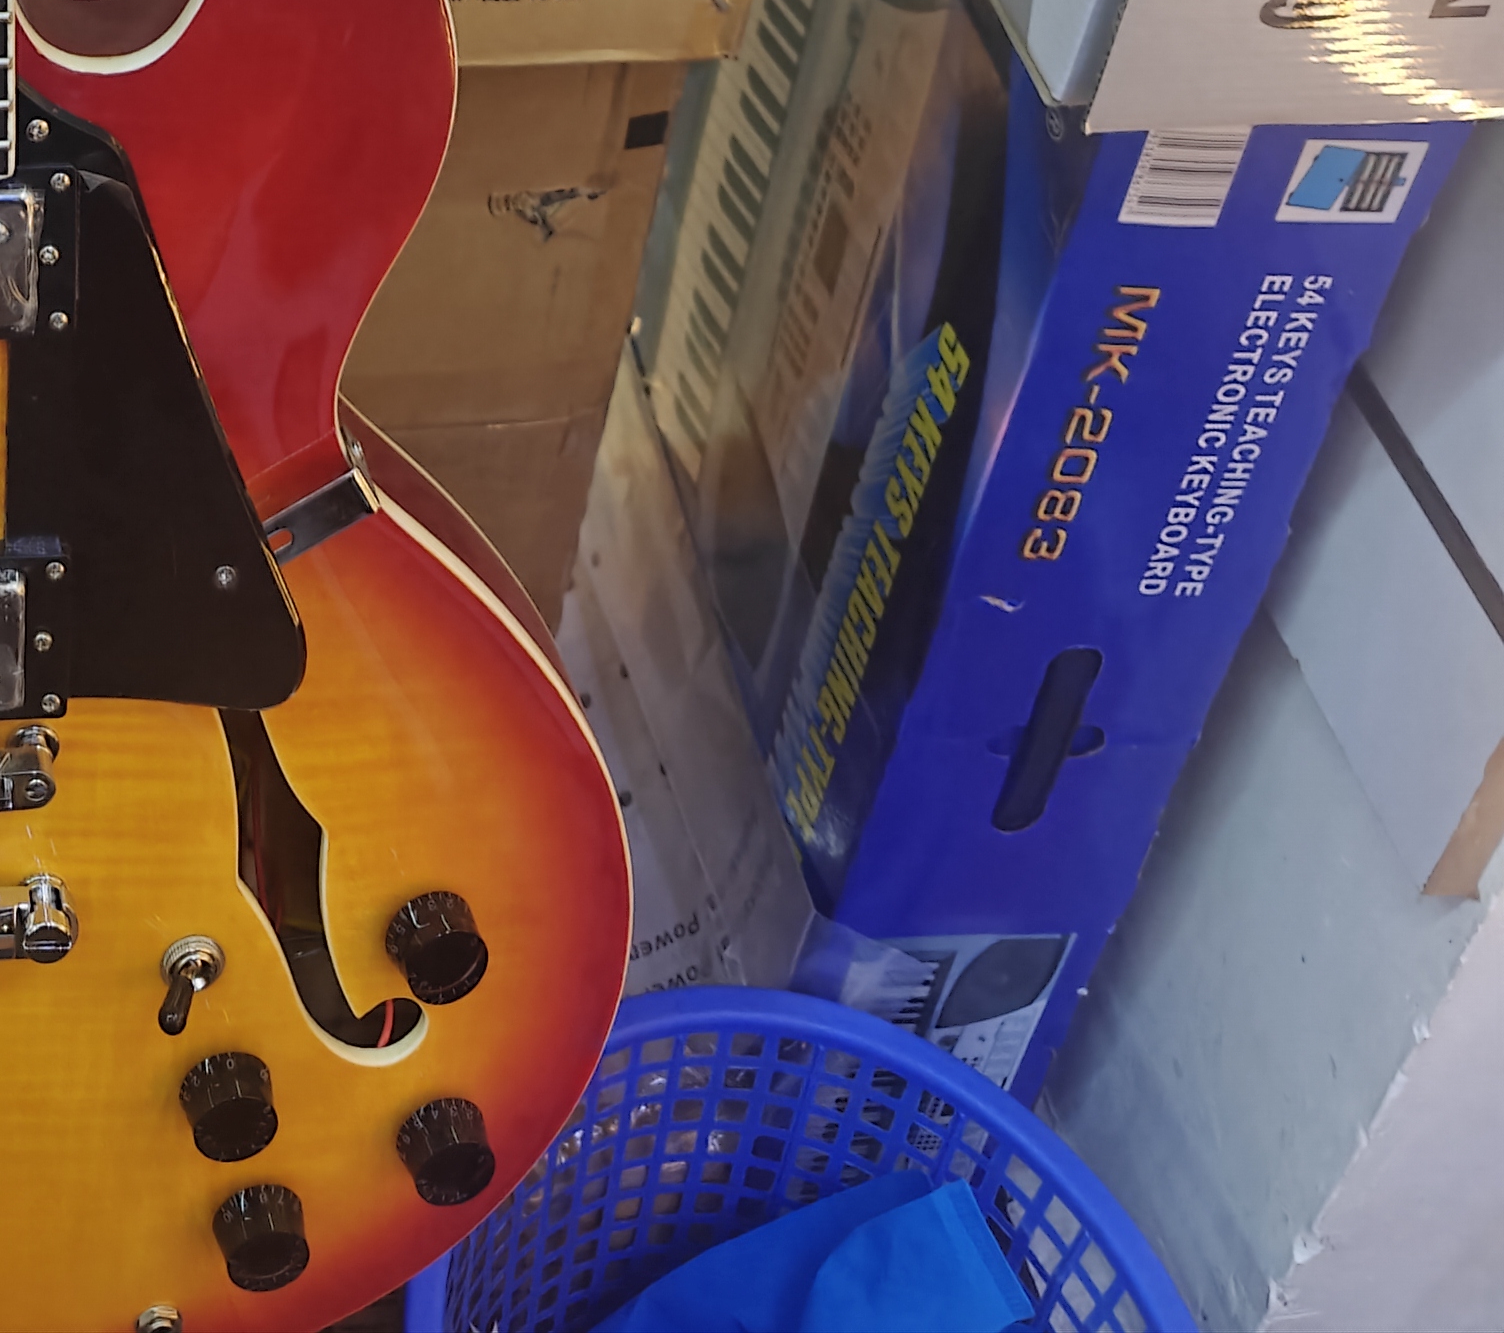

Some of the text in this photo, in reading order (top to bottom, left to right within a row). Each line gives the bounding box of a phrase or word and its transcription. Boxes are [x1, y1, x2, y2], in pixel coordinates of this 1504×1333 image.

[1021, 285, 1161, 561] MK-2083
[1138, 273, 1293, 597] ELECTRONIC KEYBOARD
[1173, 274, 1334, 597] 54 KEYS TEACHING-TYPE
